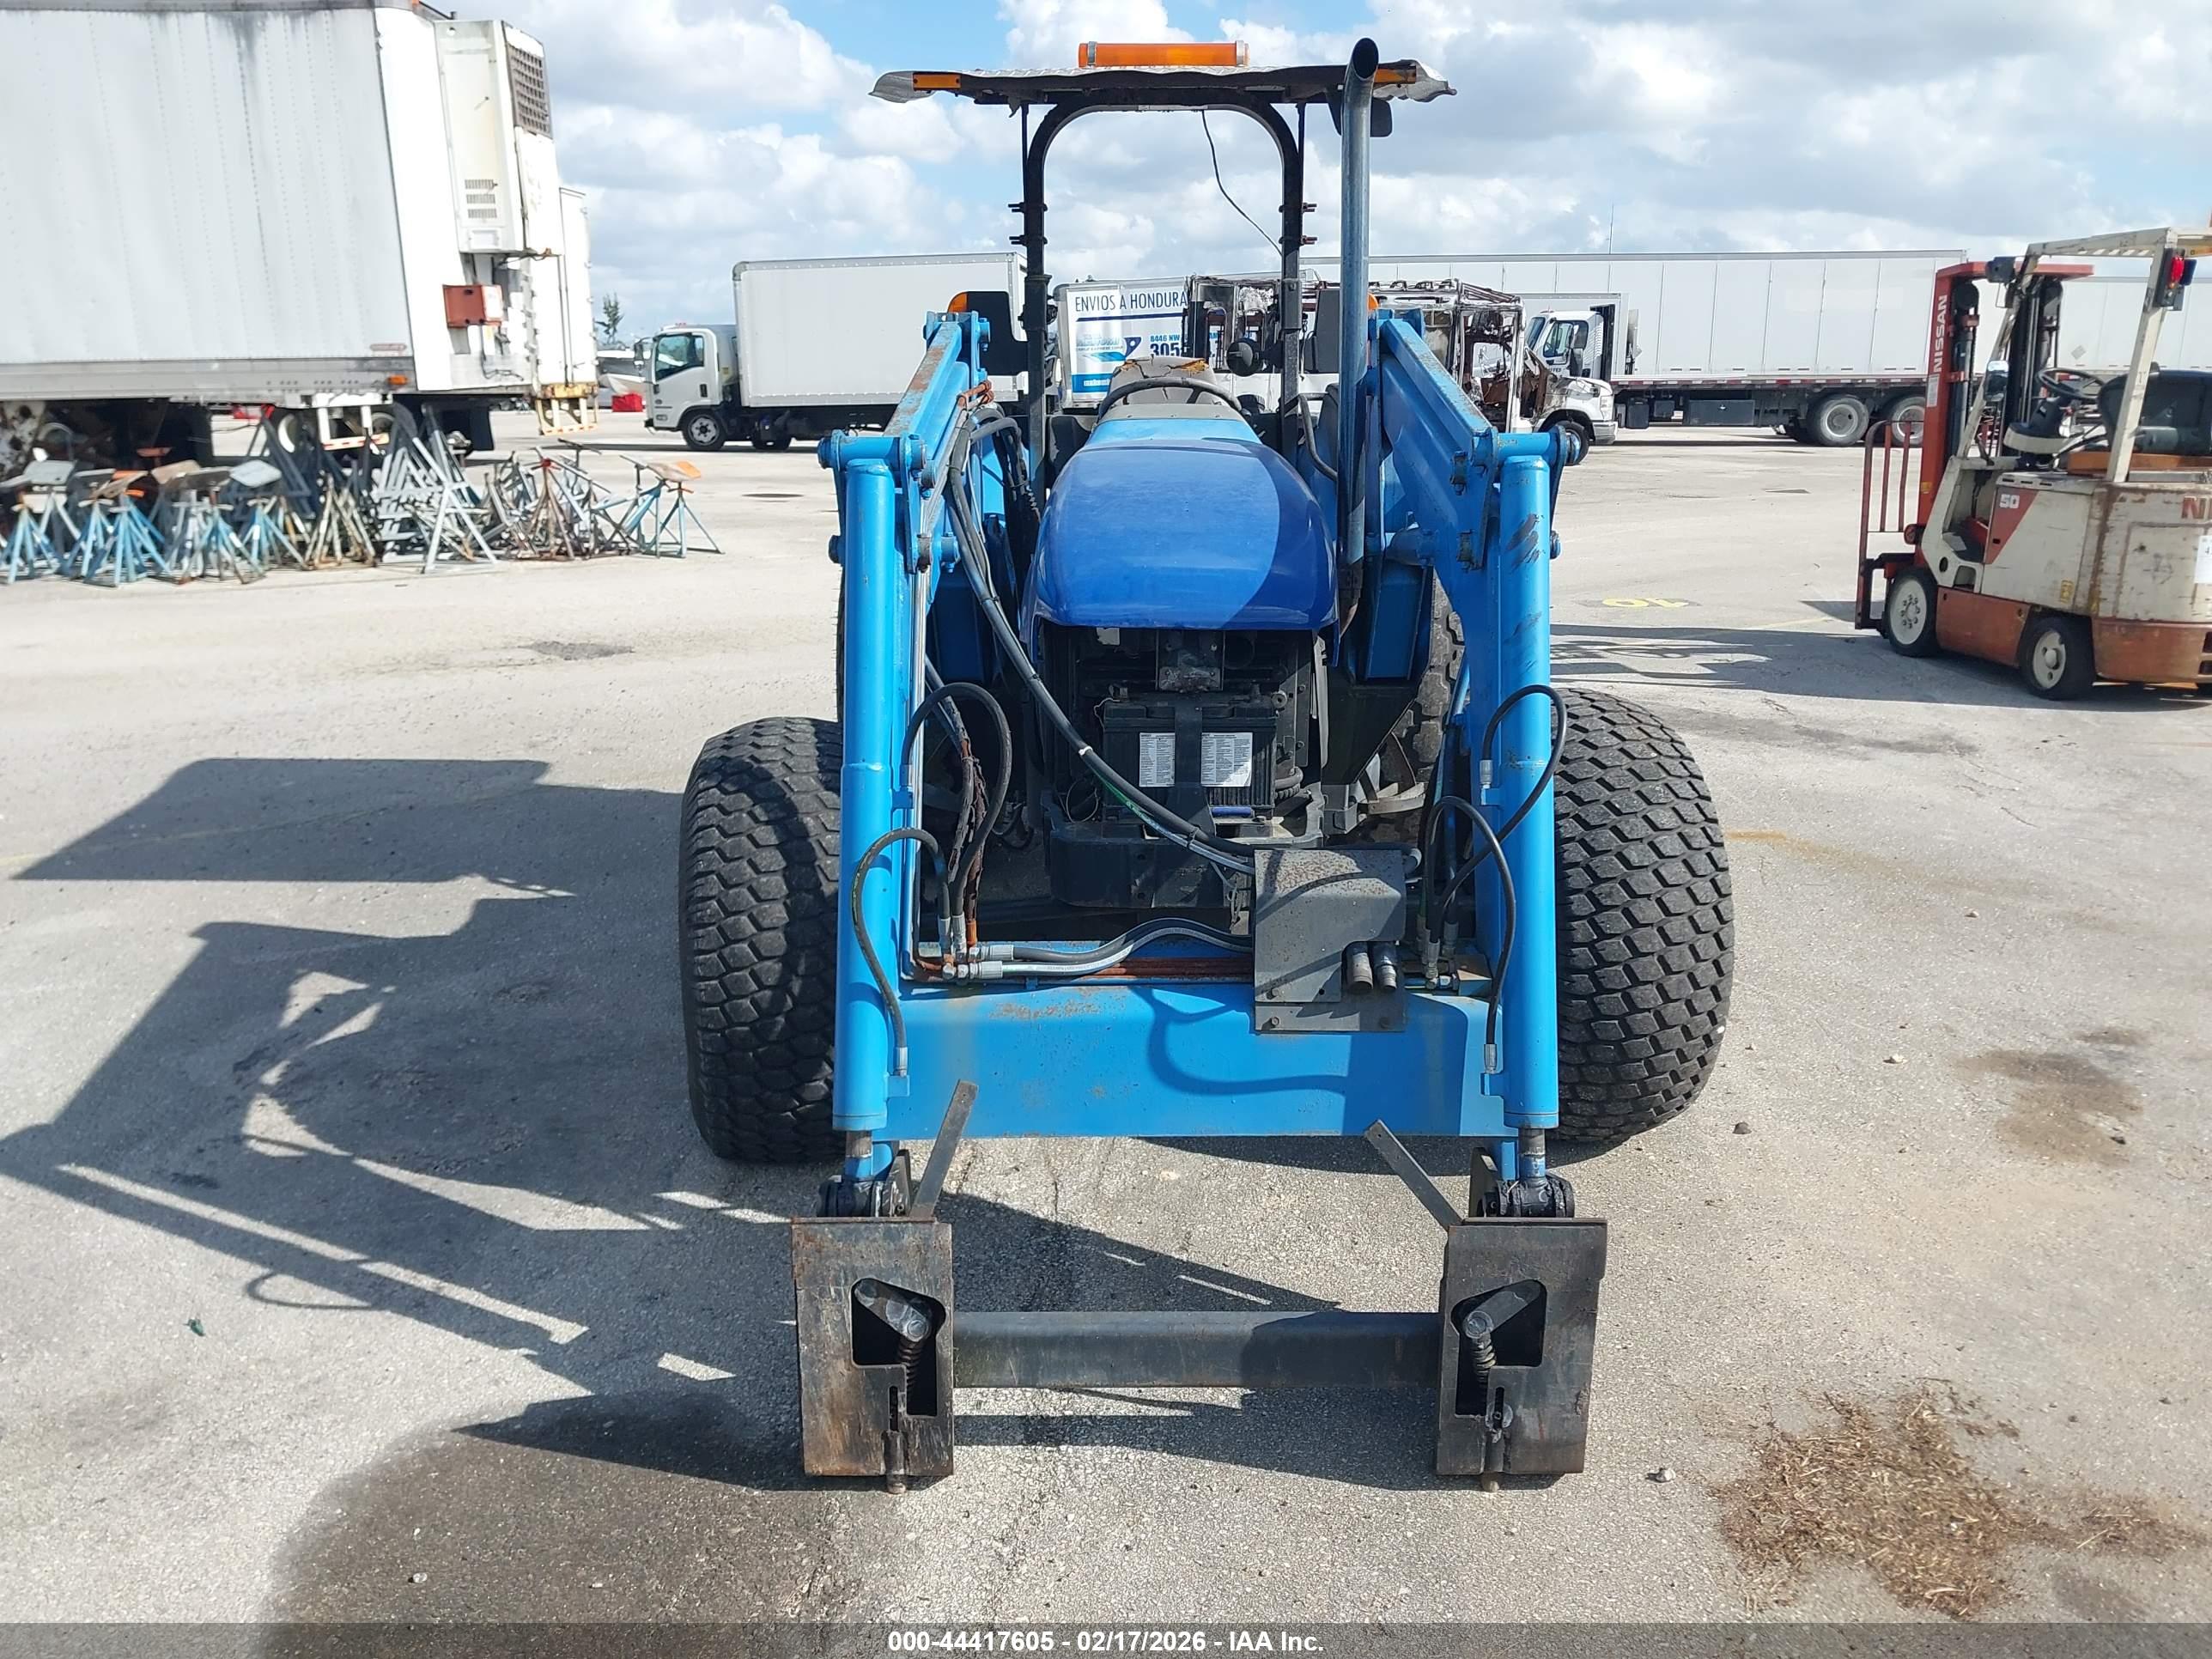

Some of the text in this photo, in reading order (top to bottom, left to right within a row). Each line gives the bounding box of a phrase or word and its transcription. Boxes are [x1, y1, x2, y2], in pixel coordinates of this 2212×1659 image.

[1075, 291, 1188, 312] ENVIOS A HONDURA
[1934, 295, 1948, 373] NISSAN
[2000, 494, 2021, 509] 50
